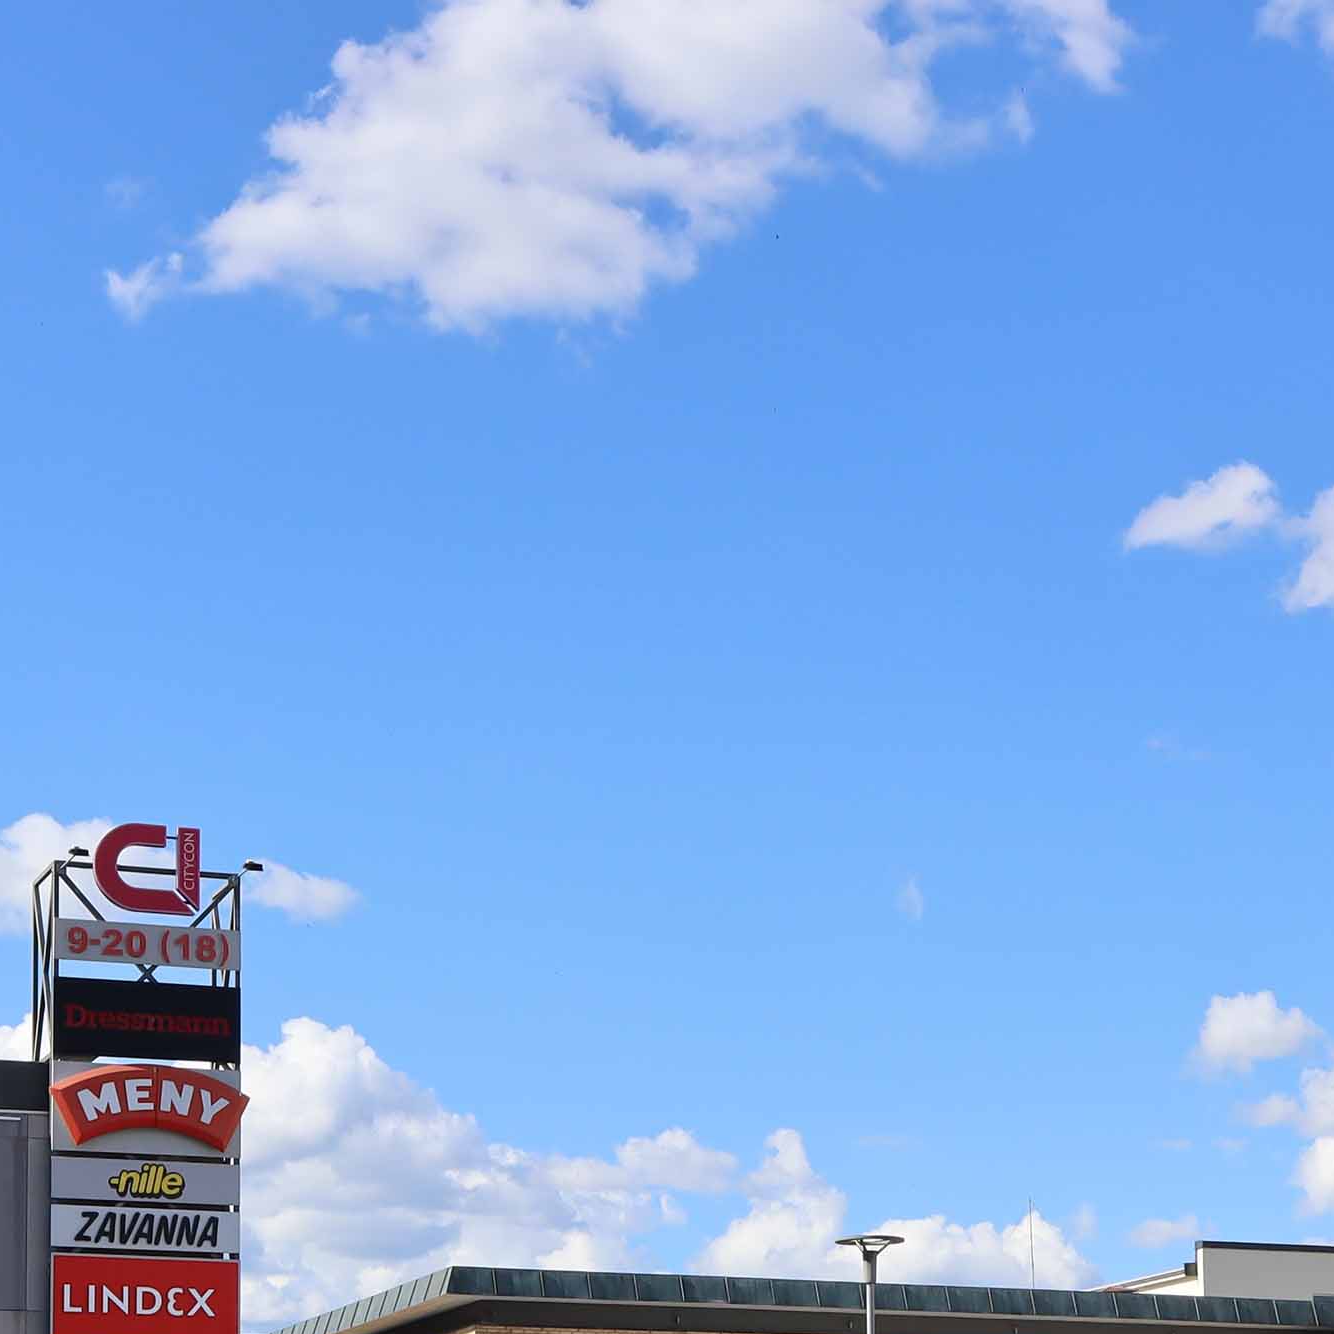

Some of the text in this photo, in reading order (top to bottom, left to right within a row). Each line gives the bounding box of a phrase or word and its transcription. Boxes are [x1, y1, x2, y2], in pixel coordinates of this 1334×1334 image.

[183, 832, 195, 890] CITYCON
[67, 926, 230, 966] 9-20 (18)
[64, 1003, 231, 1036] Dressmann
[76, 1078, 230, 1126] MENY
[74, 1211, 219, 1248] ZAVANNA
[63, 1283, 215, 1318] LINDEX
